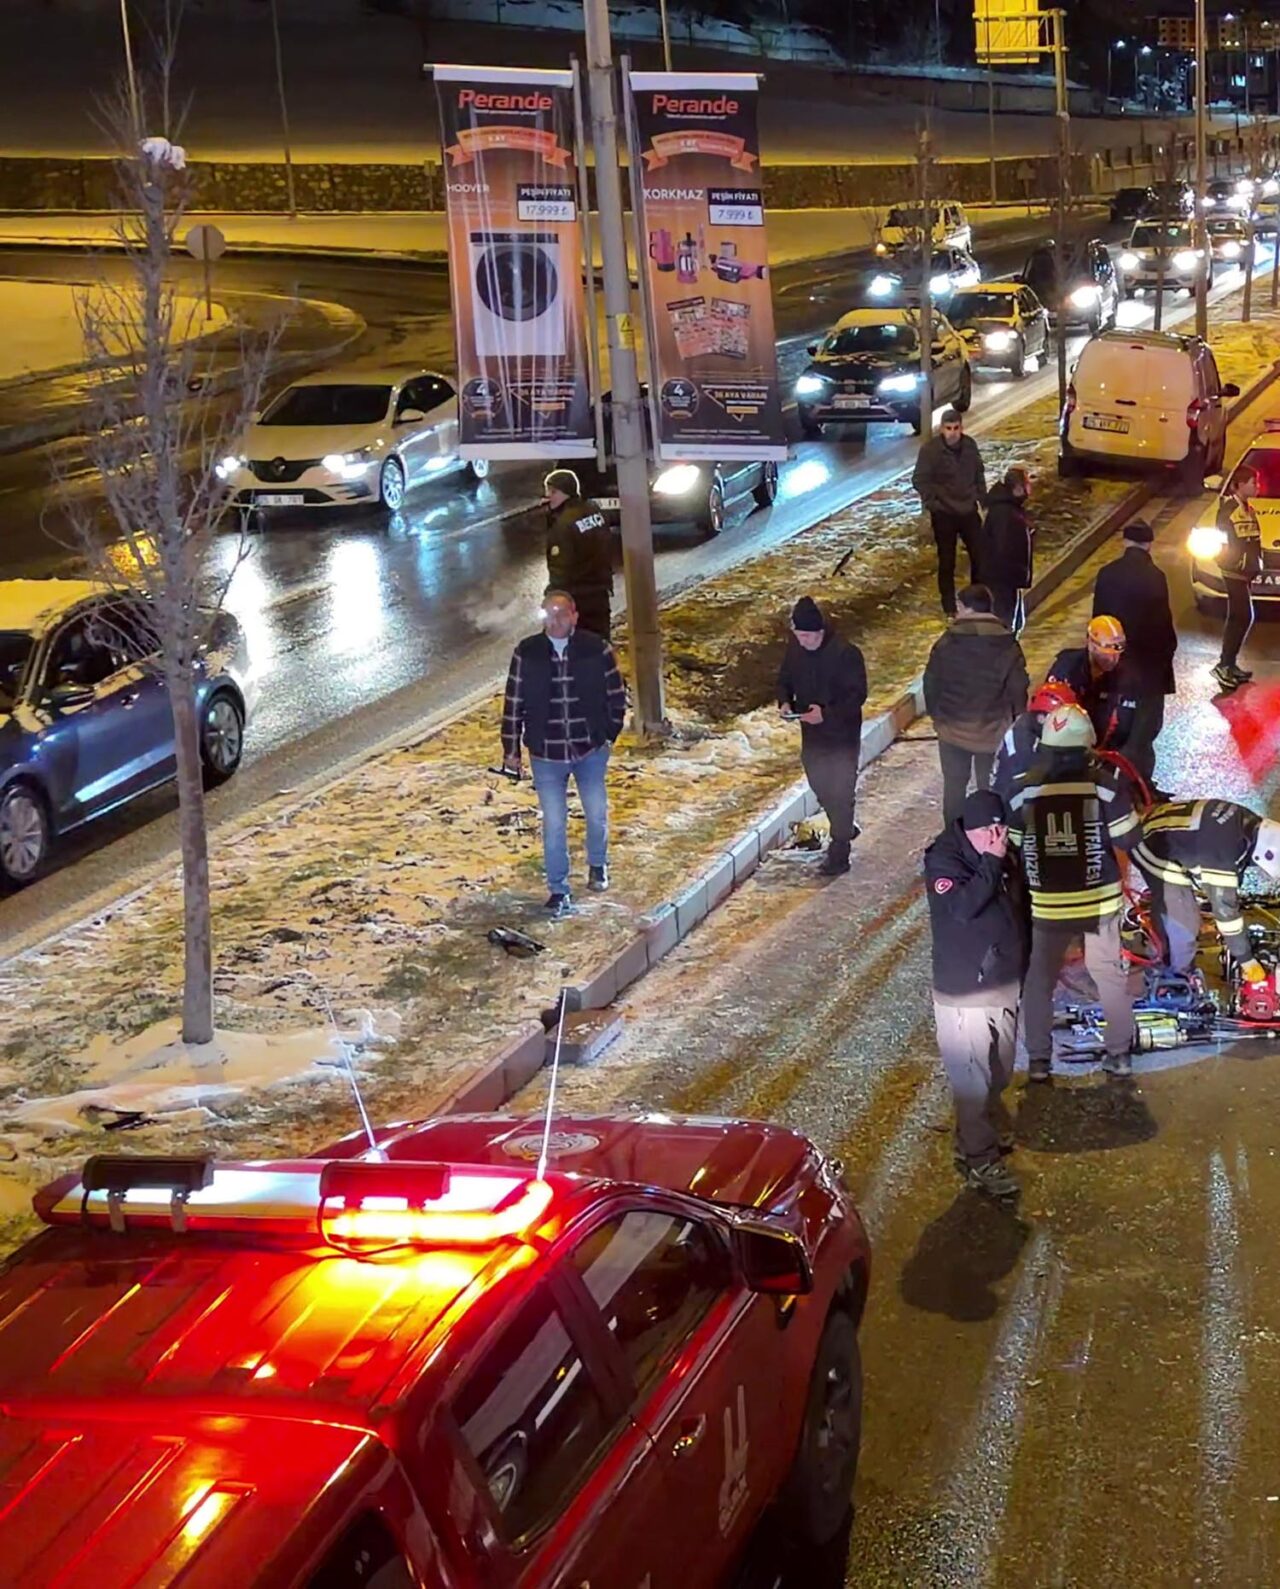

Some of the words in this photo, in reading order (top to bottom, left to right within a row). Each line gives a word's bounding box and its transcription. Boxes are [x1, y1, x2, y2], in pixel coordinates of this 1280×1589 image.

[458, 89, 553, 110] Perande
[652, 94, 739, 115] Perande
[446, 183, 490, 193] HOOVER
[643, 188, 704, 200] KORKMAZ
[476, 383, 487, 395] 4
[673, 384, 684, 396] 4
[1251, 574, 1263, 584] 5
[1265, 576, 1273, 584] A
